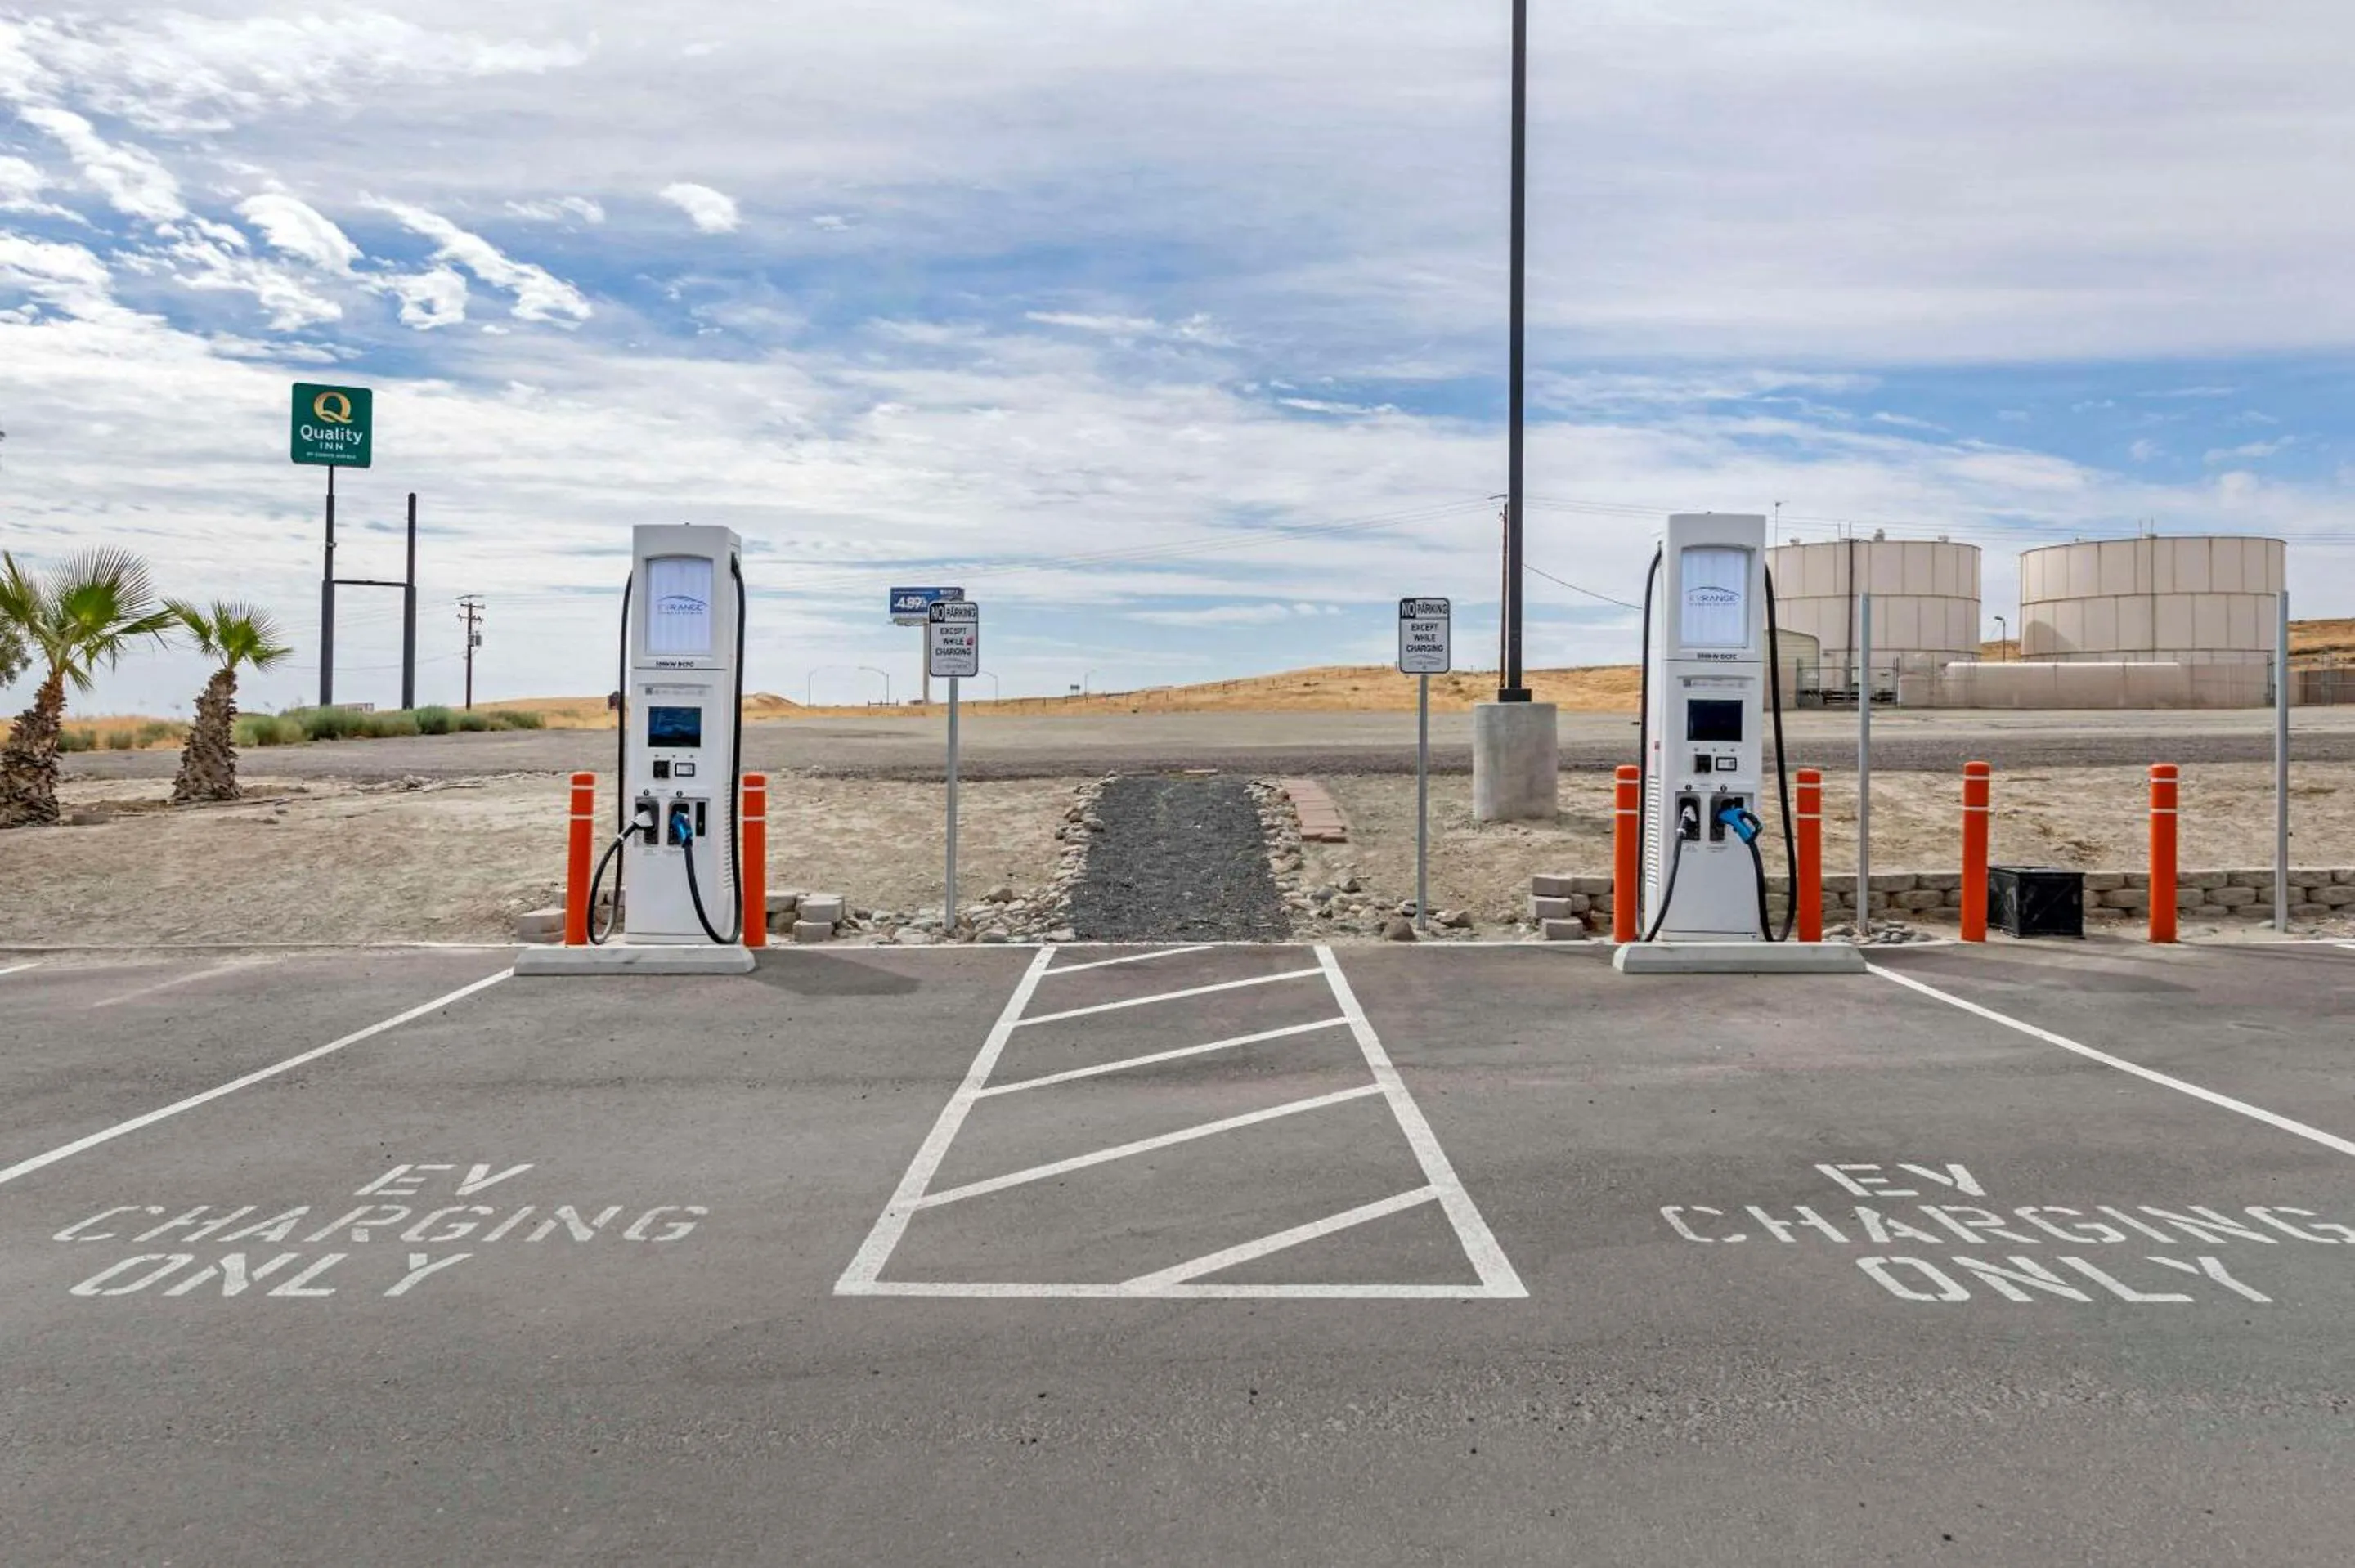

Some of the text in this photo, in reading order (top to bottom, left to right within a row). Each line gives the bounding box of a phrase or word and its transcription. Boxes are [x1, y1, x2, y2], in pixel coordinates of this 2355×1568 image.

[314, 391, 353, 423] Q
[300, 424, 363, 445] Quality
[320, 441, 343, 450] INN
[931, 605, 976, 621] NO PARKING
[1402, 602, 1447, 616] NO PARKING
[940, 627, 967, 635] EXCEPT
[1411, 623, 1438, 632] EXCEPT
[935, 647, 971, 656] CHARGING
[943, 638, 964, 646] WHILE
[353, 1164, 535, 1195] EV
[1814, 1163, 1987, 1197] EV
[52, 1205, 709, 1242] CHARGING
[1659, 1205, 2355, 1244] CHARGING
[69, 1253, 473, 1297] ONLY
[1855, 1256, 2274, 1302] ONLY
